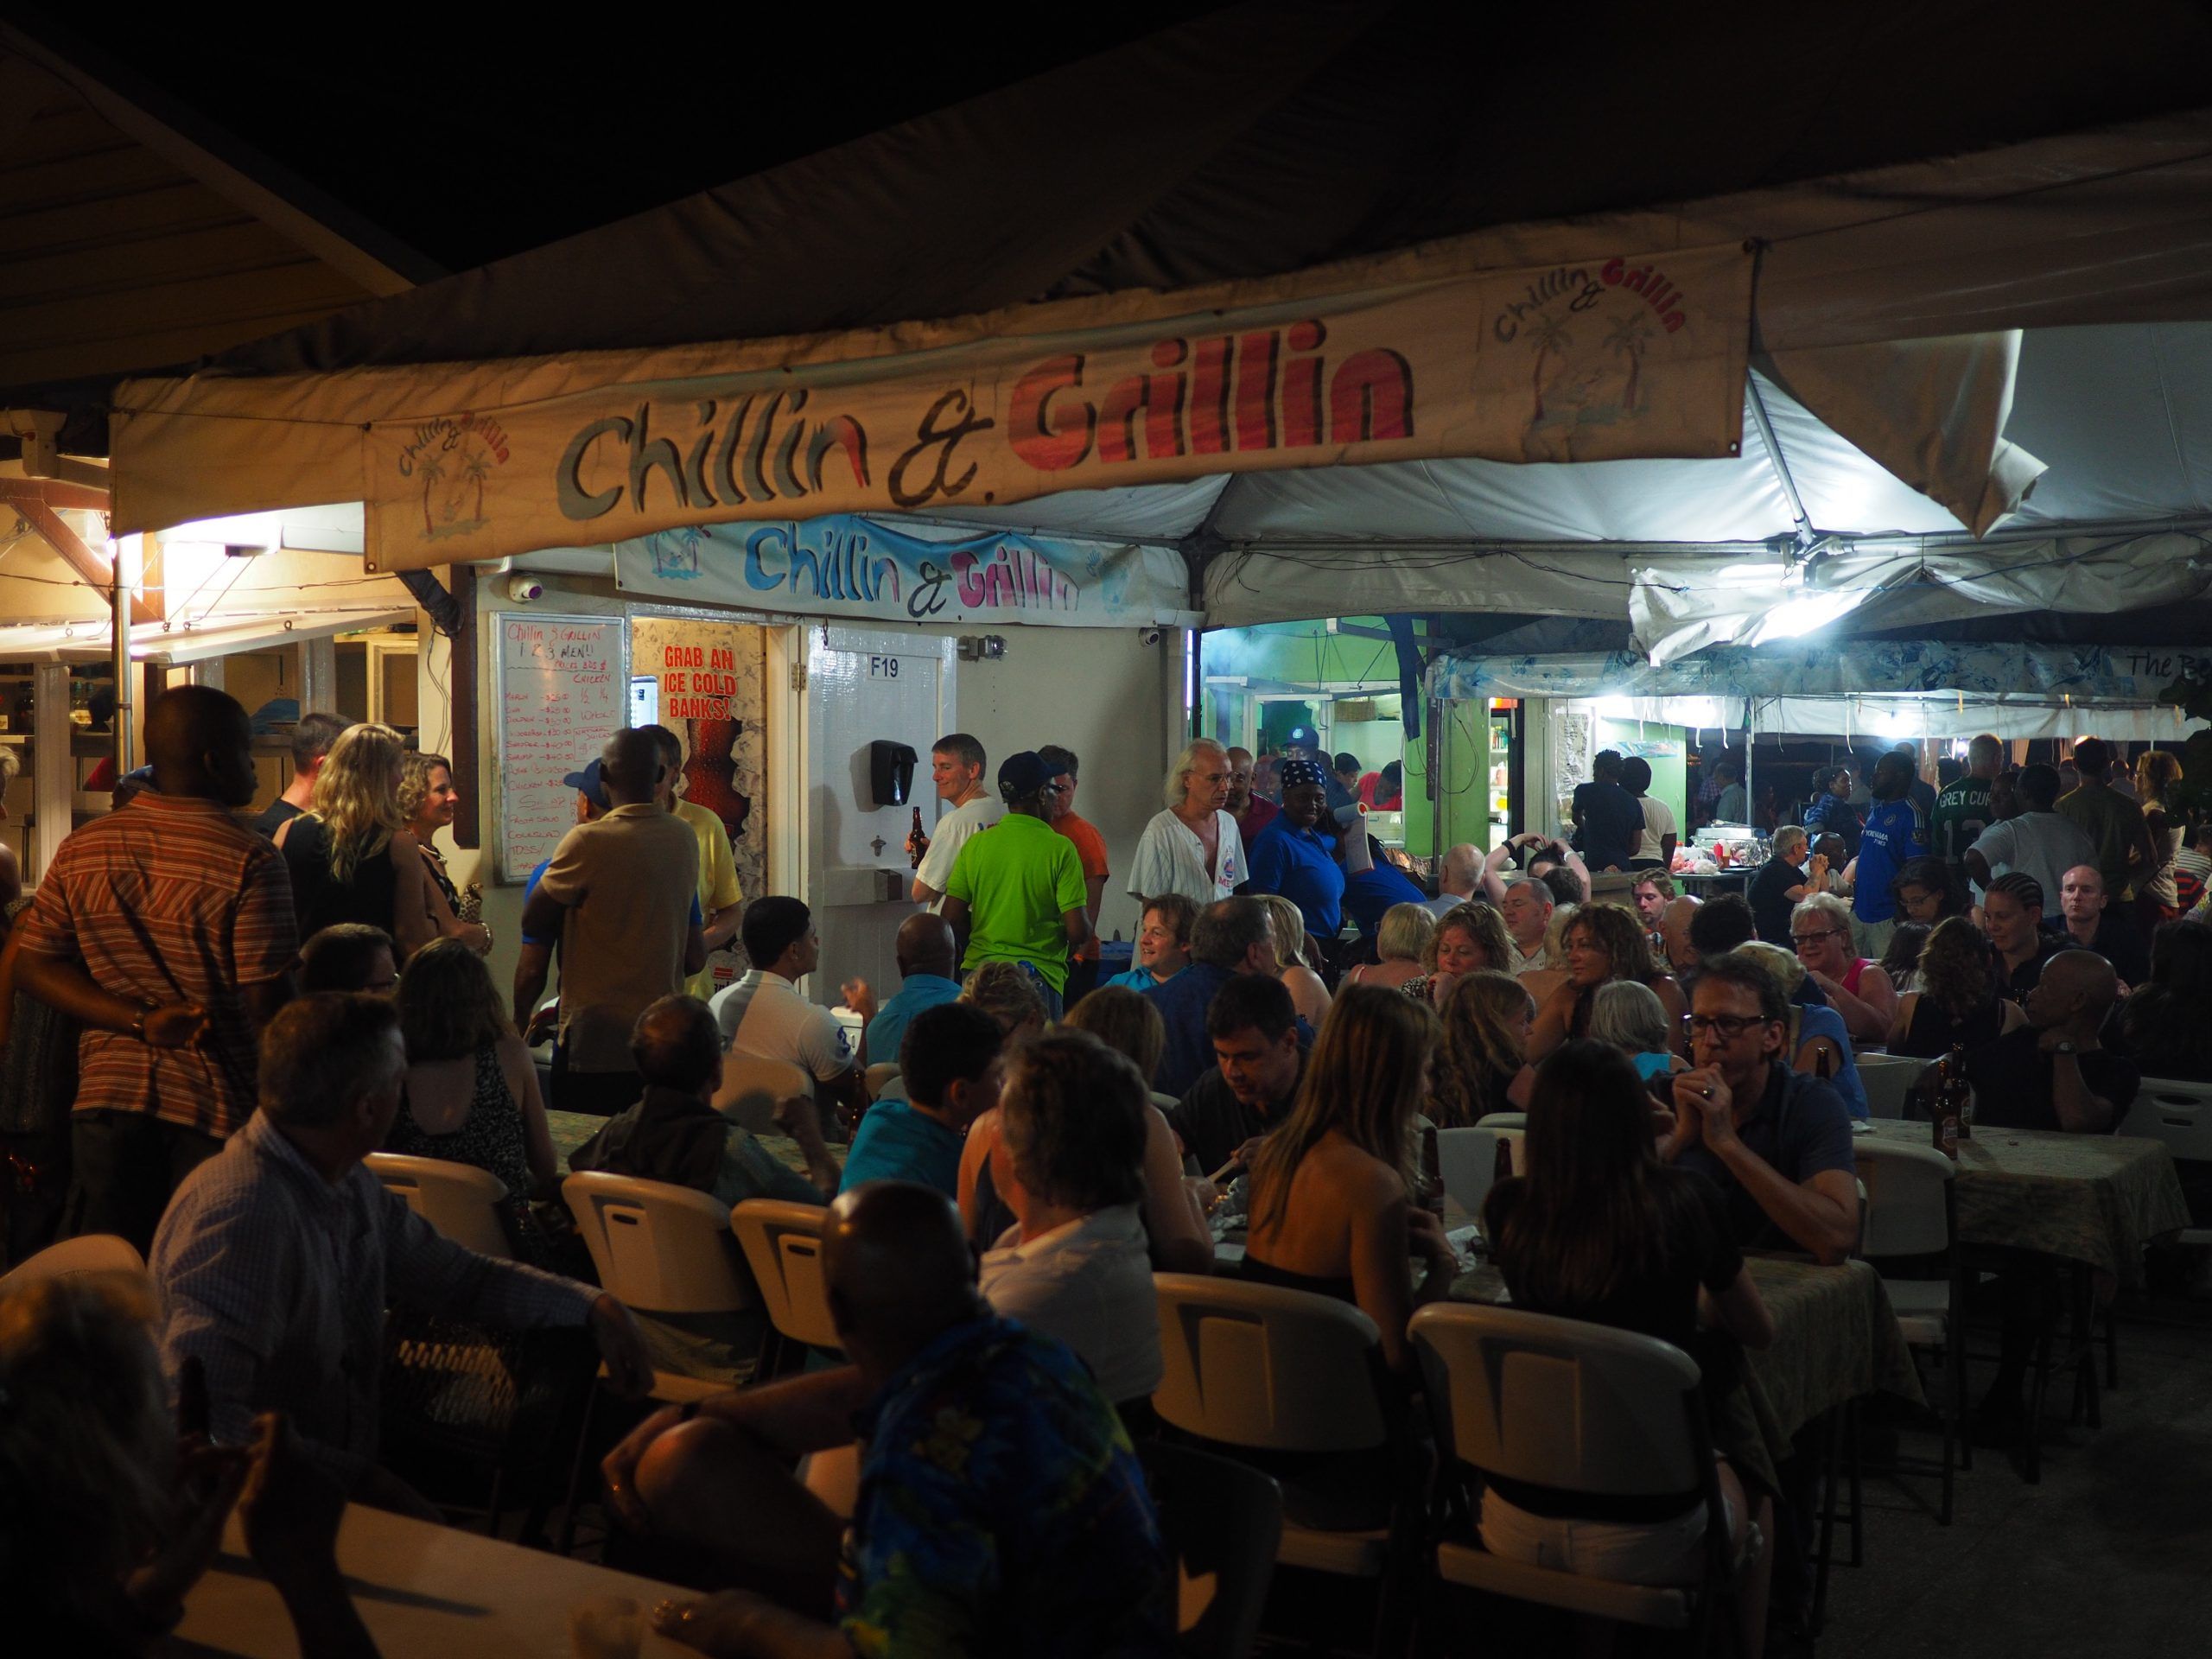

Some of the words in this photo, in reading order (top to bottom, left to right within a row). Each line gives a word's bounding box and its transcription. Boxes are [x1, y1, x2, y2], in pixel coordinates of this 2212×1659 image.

[1493, 266, 1589, 343] Chillin
[1601, 257, 1686, 334] Grillin
[556, 389, 871, 520] Chillin
[887, 388, 995, 508] &
[1007, 318, 1414, 472] Grillin
[744, 521, 899, 604] Chillin
[907, 561, 953, 619] &
[950, 545, 1081, 612] Grillin
[664, 645, 703, 668] GRAB
[710, 648, 734, 671] AN
[871, 656, 899, 678] F19
[2126, 650, 2172, 678] The
[664, 672, 686, 693] ICE
[692, 672, 737, 696] COLD
[669, 696, 732, 721] BANKS!
[1939, 790, 1967, 808] GREY
